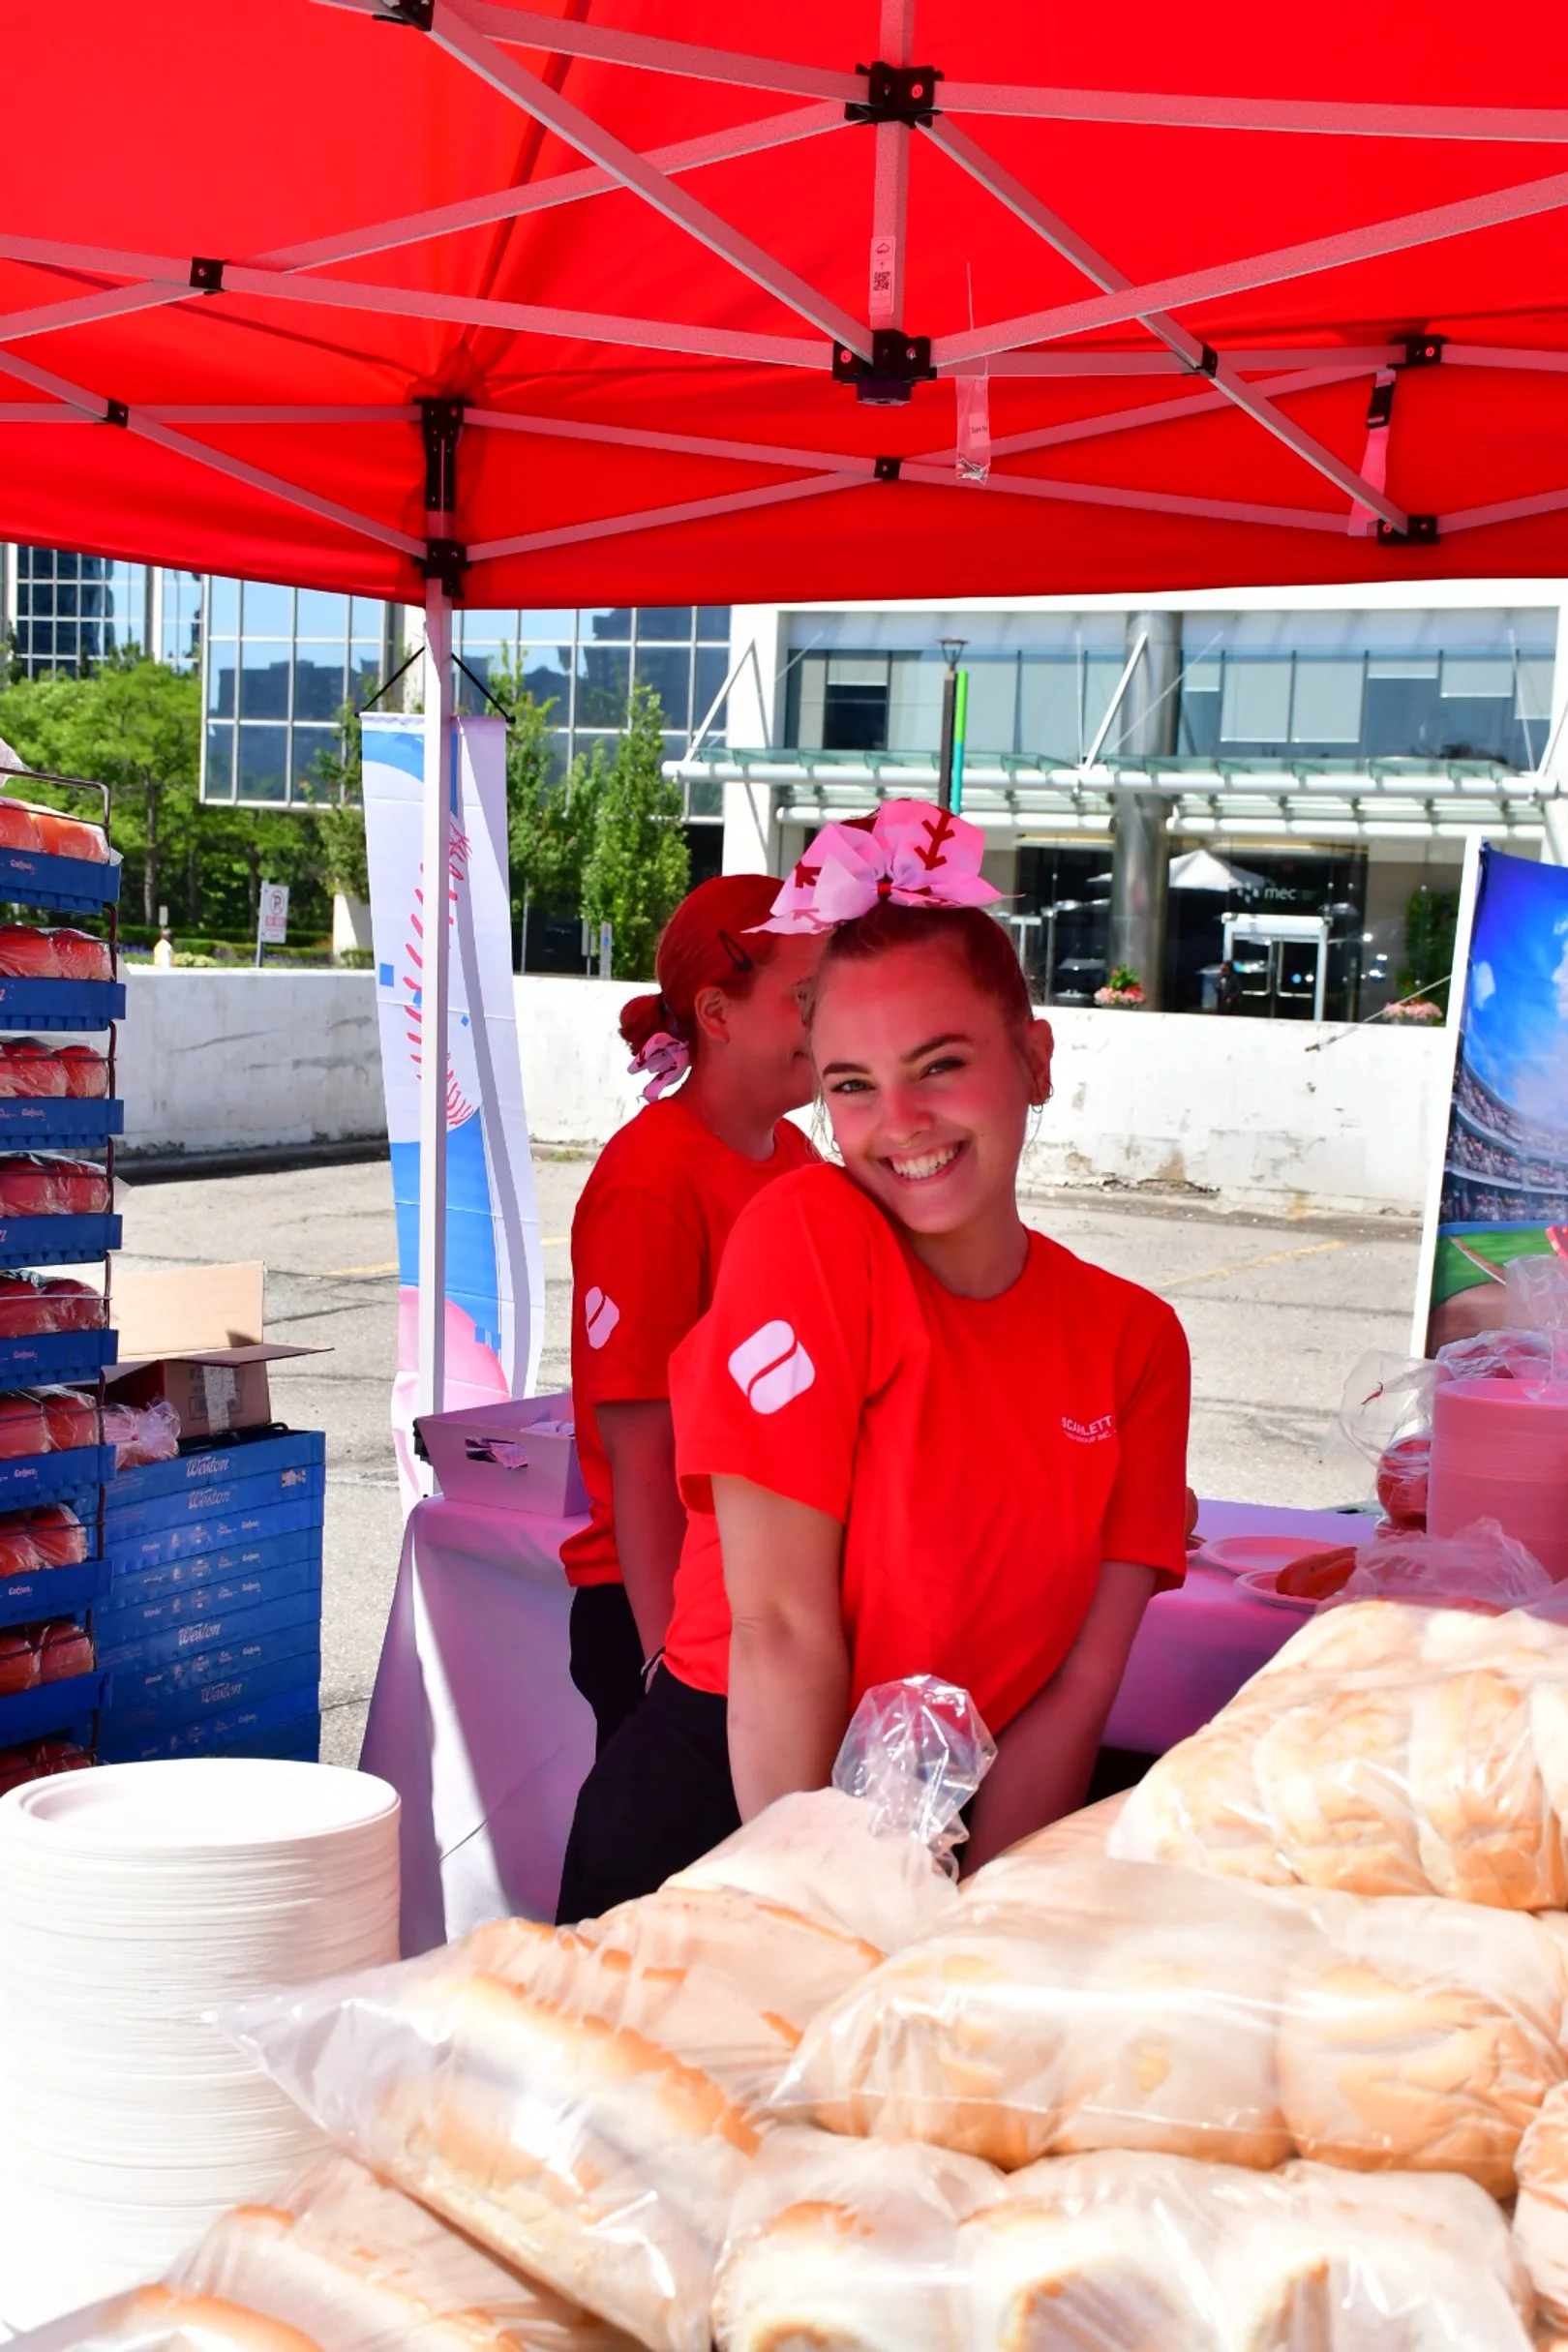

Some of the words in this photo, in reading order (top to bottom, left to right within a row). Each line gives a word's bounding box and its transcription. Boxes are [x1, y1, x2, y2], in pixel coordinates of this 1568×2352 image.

[1264, 887, 1297, 901] mec
[1061, 1414, 1112, 1436] SCARLETT
[186, 1456, 229, 1478] Weston
[188, 1489, 231, 1510] Weston
[178, 1622, 222, 1646] Weston
[200, 1682, 243, 1704] Weston
